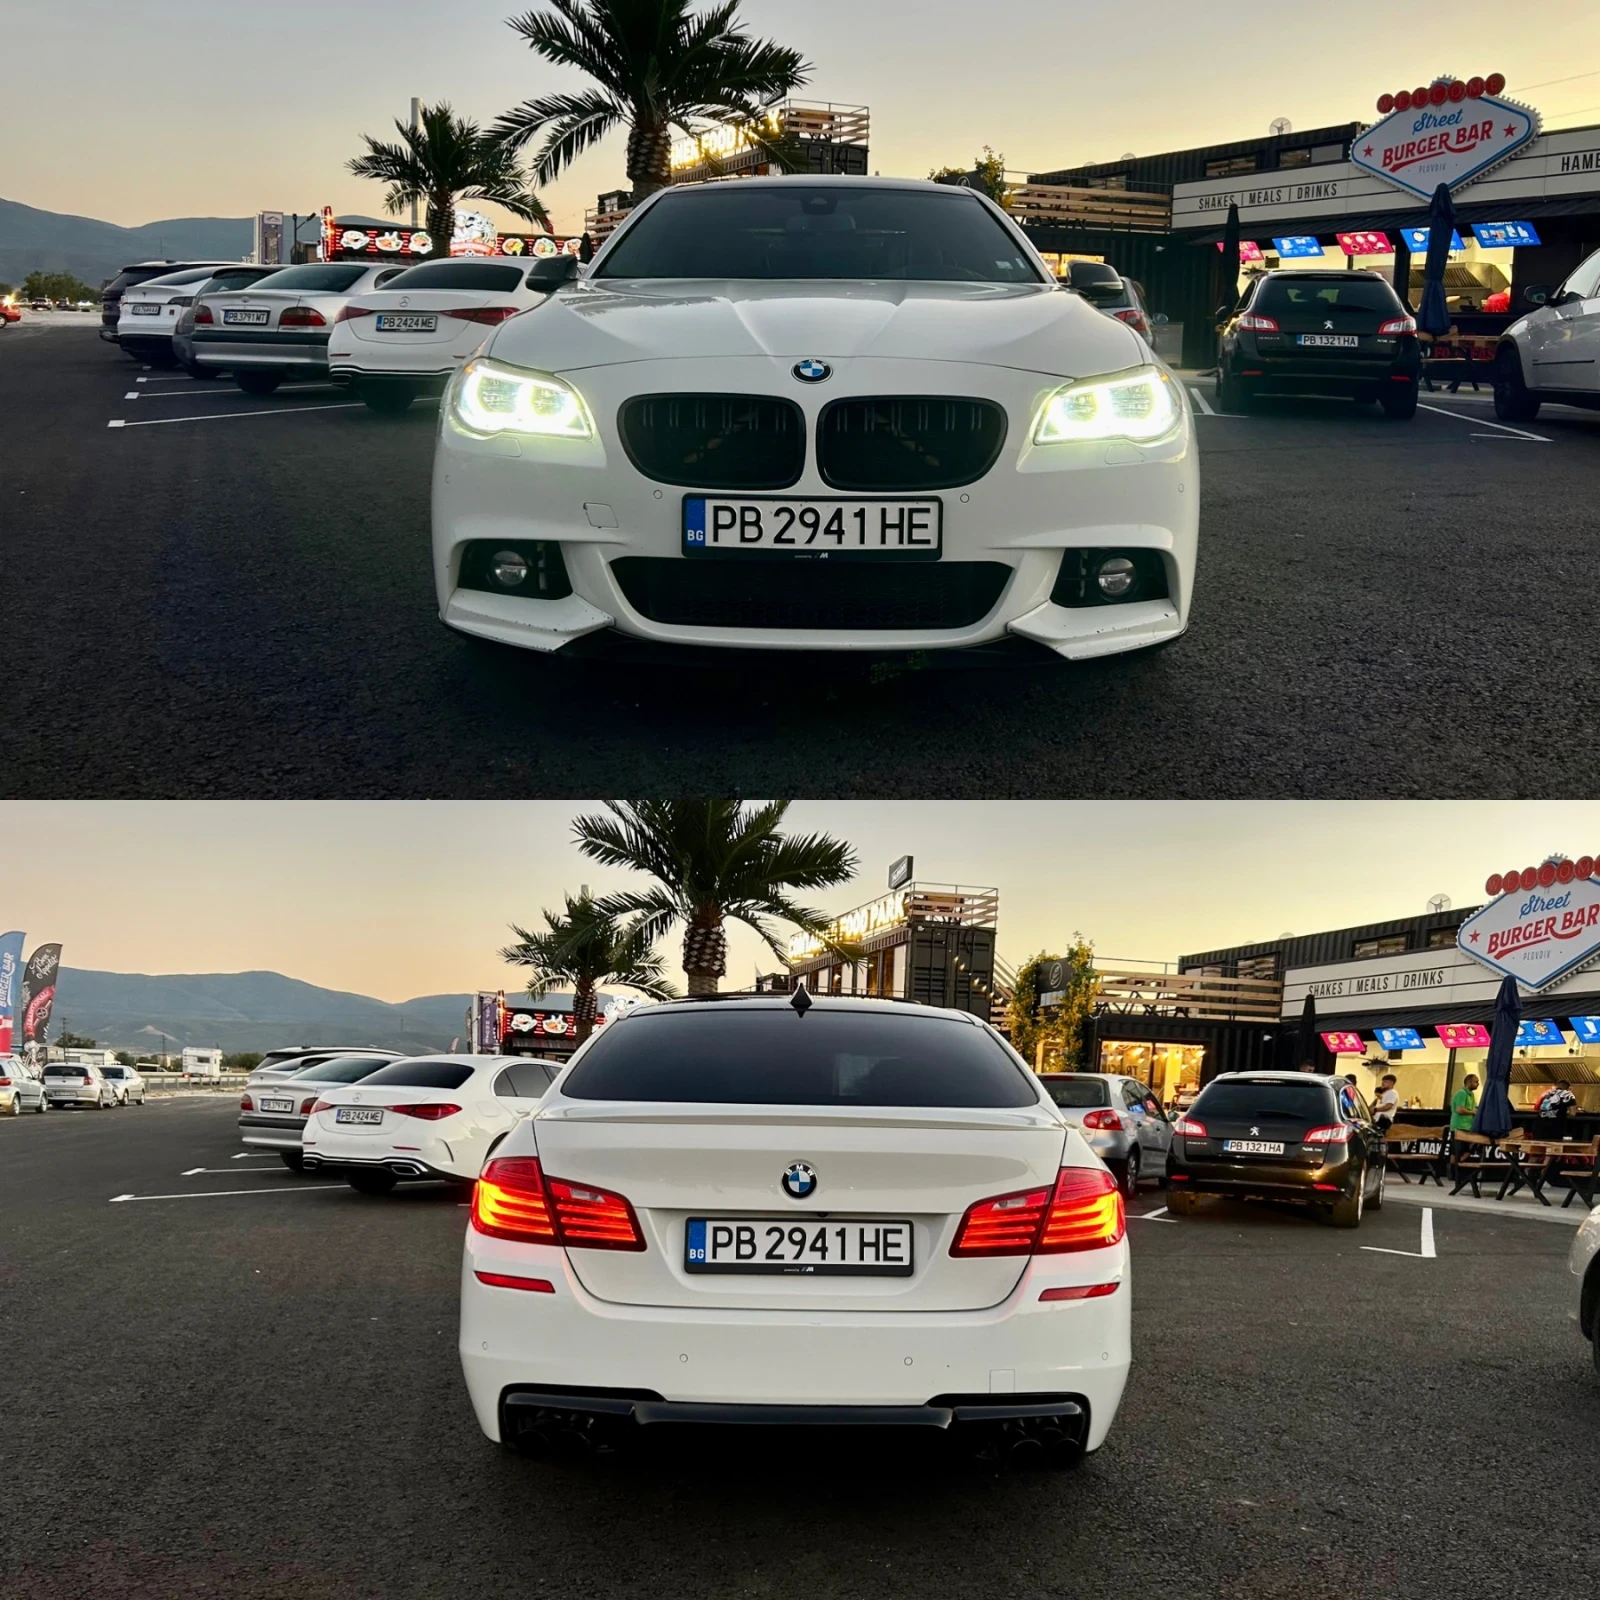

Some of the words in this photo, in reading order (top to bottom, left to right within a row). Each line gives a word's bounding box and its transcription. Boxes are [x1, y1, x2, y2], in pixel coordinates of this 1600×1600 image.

[1379, 76, 1500, 109] WELCOME
[1412, 109, 1463, 135] Street
[1382, 131, 1450, 168] BURGER
[1456, 120, 1494, 145] BAR
[1199, 195, 1235, 210] SHAKES
[1249, 190, 1282, 204] MEALS
[1297, 183, 1337, 200] DRINKS
[383, 317, 395, 328] PB
[396, 317, 420, 328] 2424
[1303, 336, 1316, 345] PB
[1319, 336, 1342, 345] 1321
[687, 529, 704, 541] BG
[712, 505, 764, 543] PB
[773, 506, 867, 545] 2941
[880, 507, 932, 545] HE
[1488, 859, 1597, 892] WELCOM
[1519, 891, 1571, 919] Street
[1487, 916, 1557, 954] BURGER
[1561, 903, 1600, 931] BAR
[1309, 982, 1343, 997] SHAKES
[1356, 977, 1388, 992] MEALS
[1403, 971, 1444, 988] DRINKS
[352, 1111, 368, 1120] 2424
[1230, 1141, 1243, 1151] PB
[1245, 1142, 1267, 1152] 1321
[1269, 1143, 1282, 1153] HA
[689, 1249, 704, 1259] BG
[712, 1226, 757, 1260] PB
[765, 1226, 846, 1261] 2941
[859, 1227, 904, 1262] HE
